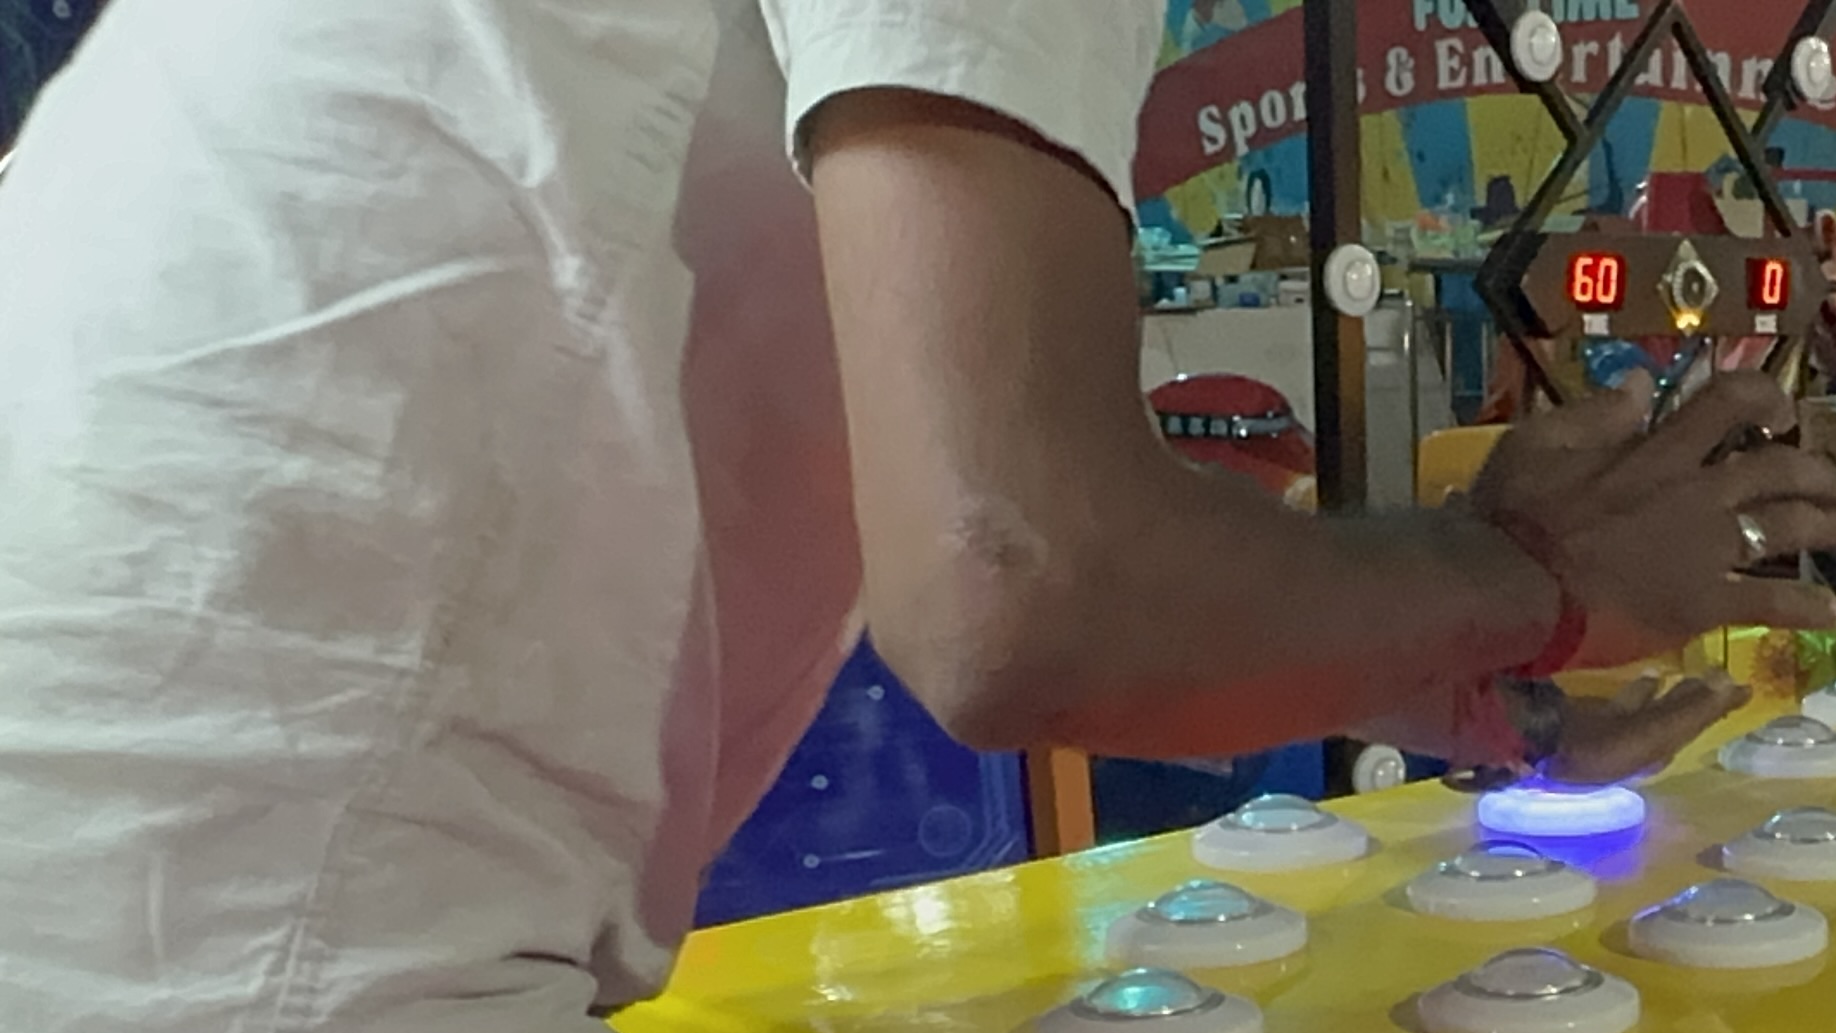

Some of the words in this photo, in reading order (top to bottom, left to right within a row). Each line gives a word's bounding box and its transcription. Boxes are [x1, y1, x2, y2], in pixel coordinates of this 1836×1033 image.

[1385, 46, 1415, 96] &
[1573, 257, 1618, 304] 60
[1762, 260, 1784, 304] 0
